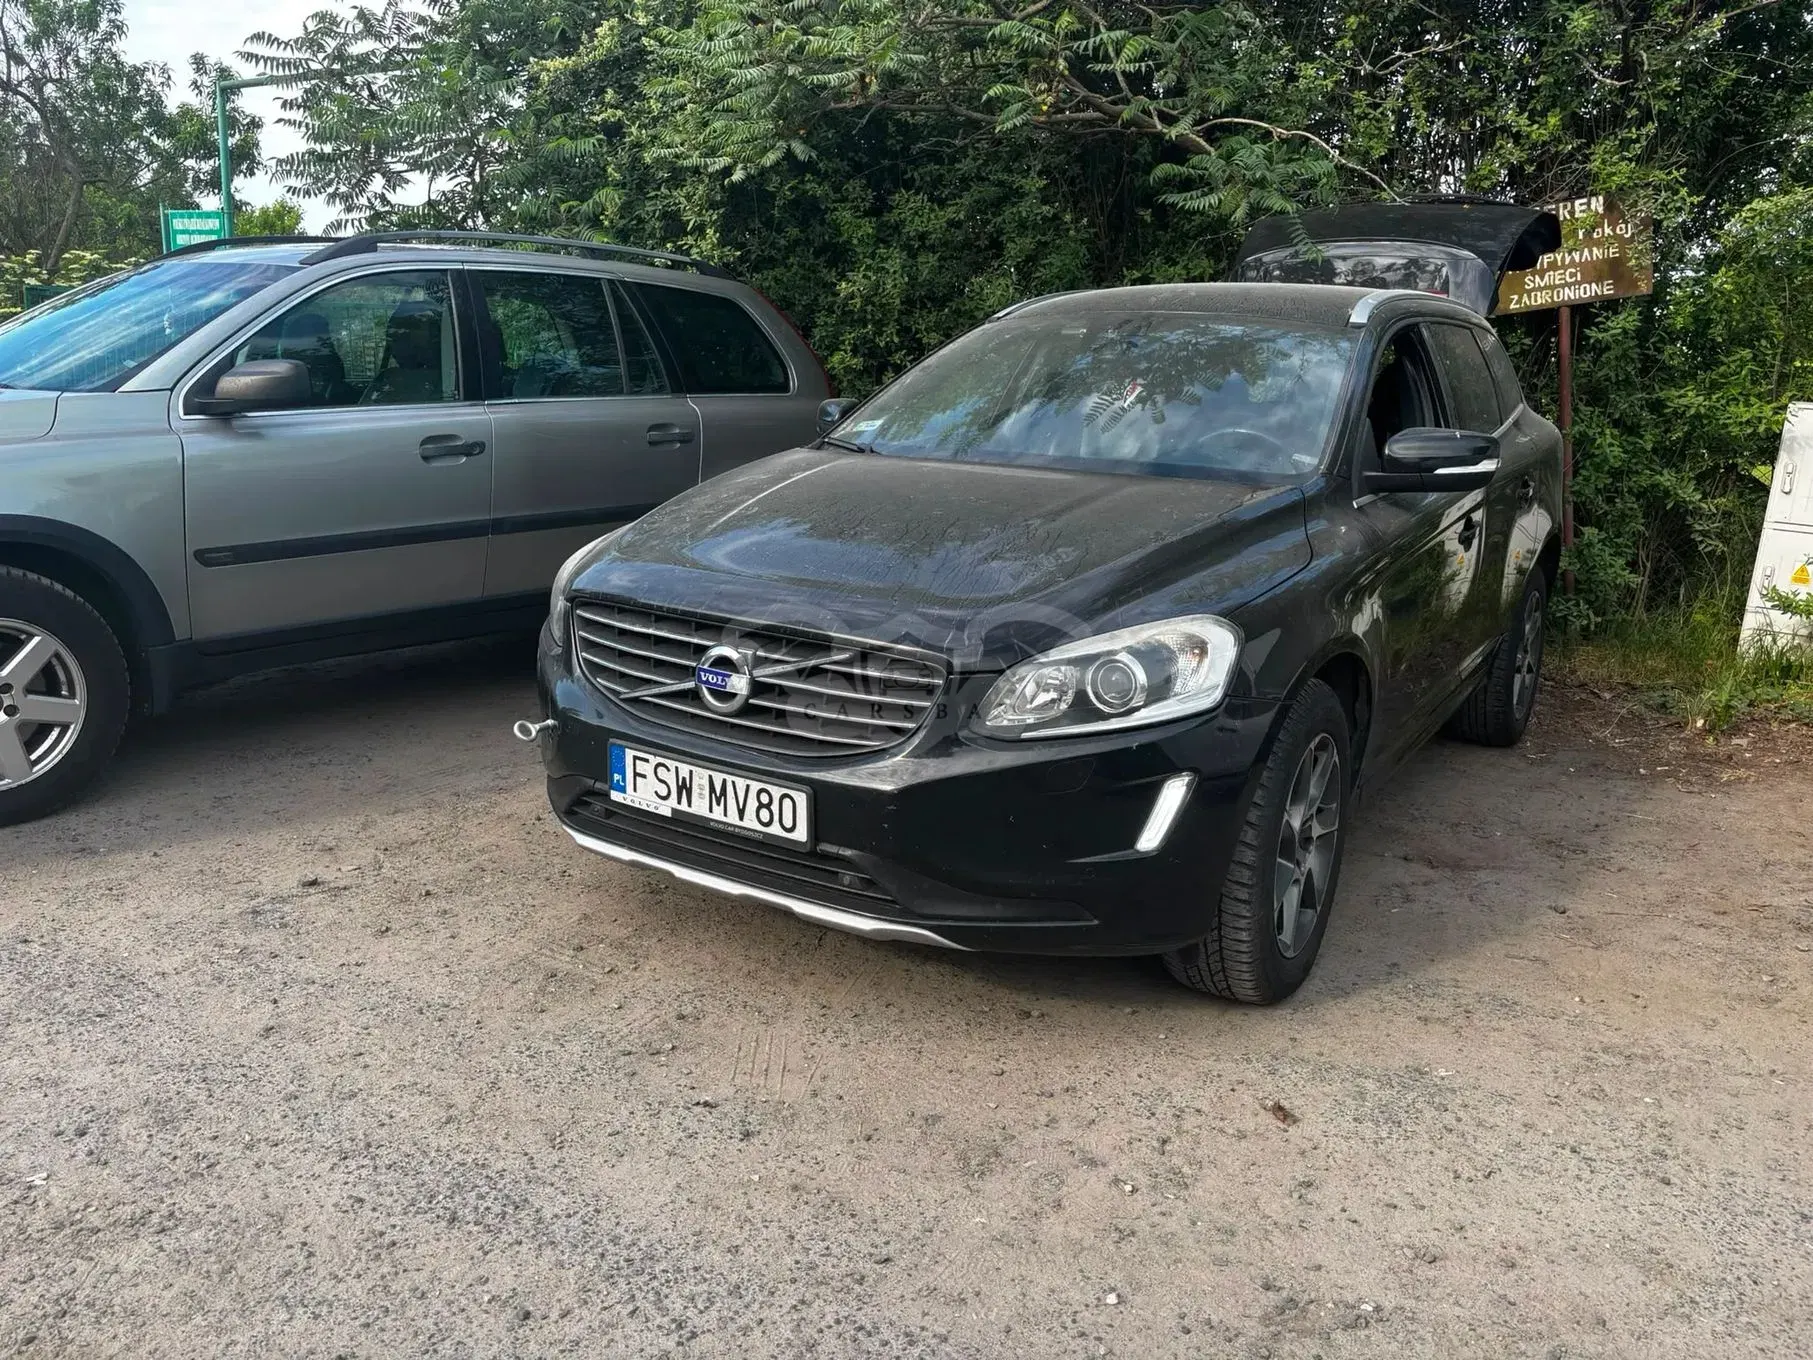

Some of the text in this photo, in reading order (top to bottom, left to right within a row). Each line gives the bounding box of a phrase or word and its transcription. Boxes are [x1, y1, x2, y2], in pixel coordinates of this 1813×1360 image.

[1533, 196, 1604, 220] EREN
[613, 773, 625, 786] PL
[622, 795, 660, 811] VOLVO
[632, 755, 797, 834] FSW MV80
